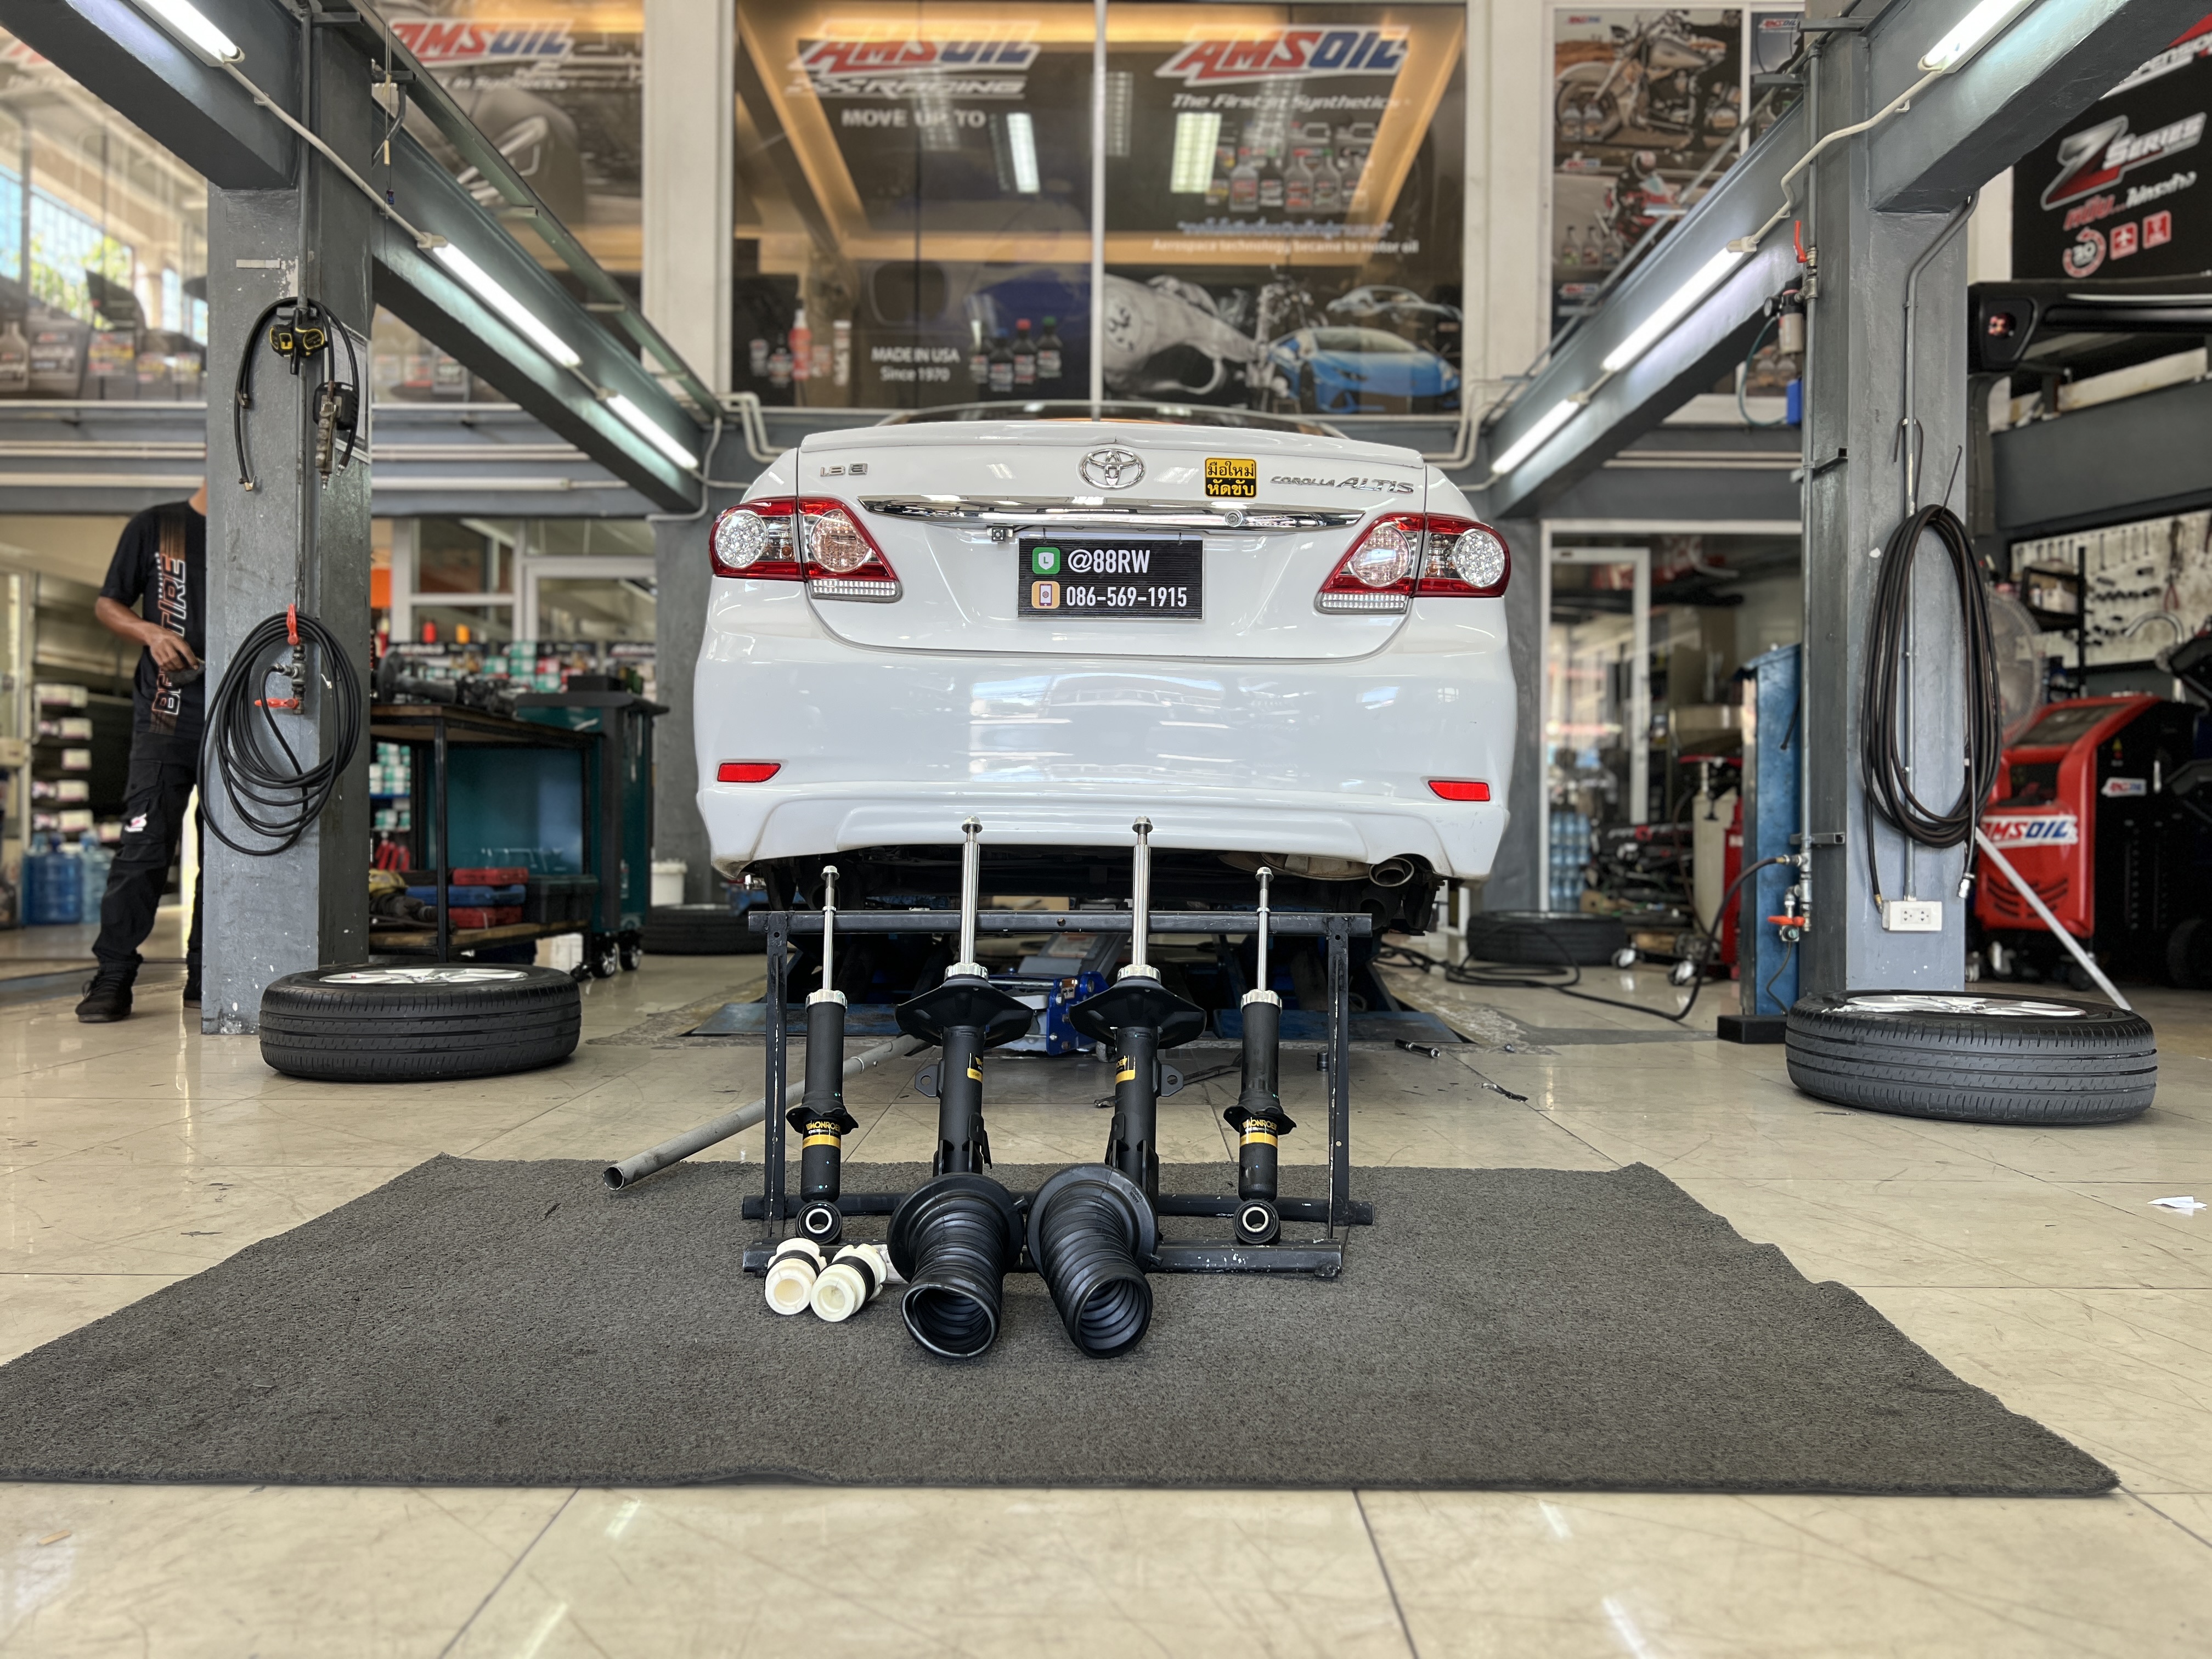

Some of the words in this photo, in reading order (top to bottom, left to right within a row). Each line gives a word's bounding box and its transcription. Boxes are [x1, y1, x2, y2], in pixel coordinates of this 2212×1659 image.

[802, 23, 1039, 74] AMSOIL
[1170, 29, 1408, 80] AMSOIL
[864, 79, 1027, 99] RACING
[1172, 94, 1210, 108] The
[1212, 94, 1262, 109] First
[842, 109, 907, 127] MOVE
[915, 110, 950, 127] UP
[956, 110, 986, 127] TO
[871, 347, 913, 363] MADE
[914, 347, 929, 362] IN
[931, 347, 961, 363] USA
[880, 366, 916, 381] Since
[918, 367, 950, 382] 1970
[1207, 460, 1254, 477] มือใหม่
[1207, 479, 1254, 495] หัดขับ
[1270, 476, 1335, 487] COROLLA
[1335, 477, 1414, 494] ALTIS
[1068, 549, 1150, 573] @88RW
[158, 553, 187, 637] TIRE
[1066, 586, 1187, 607] 086-569-1915
